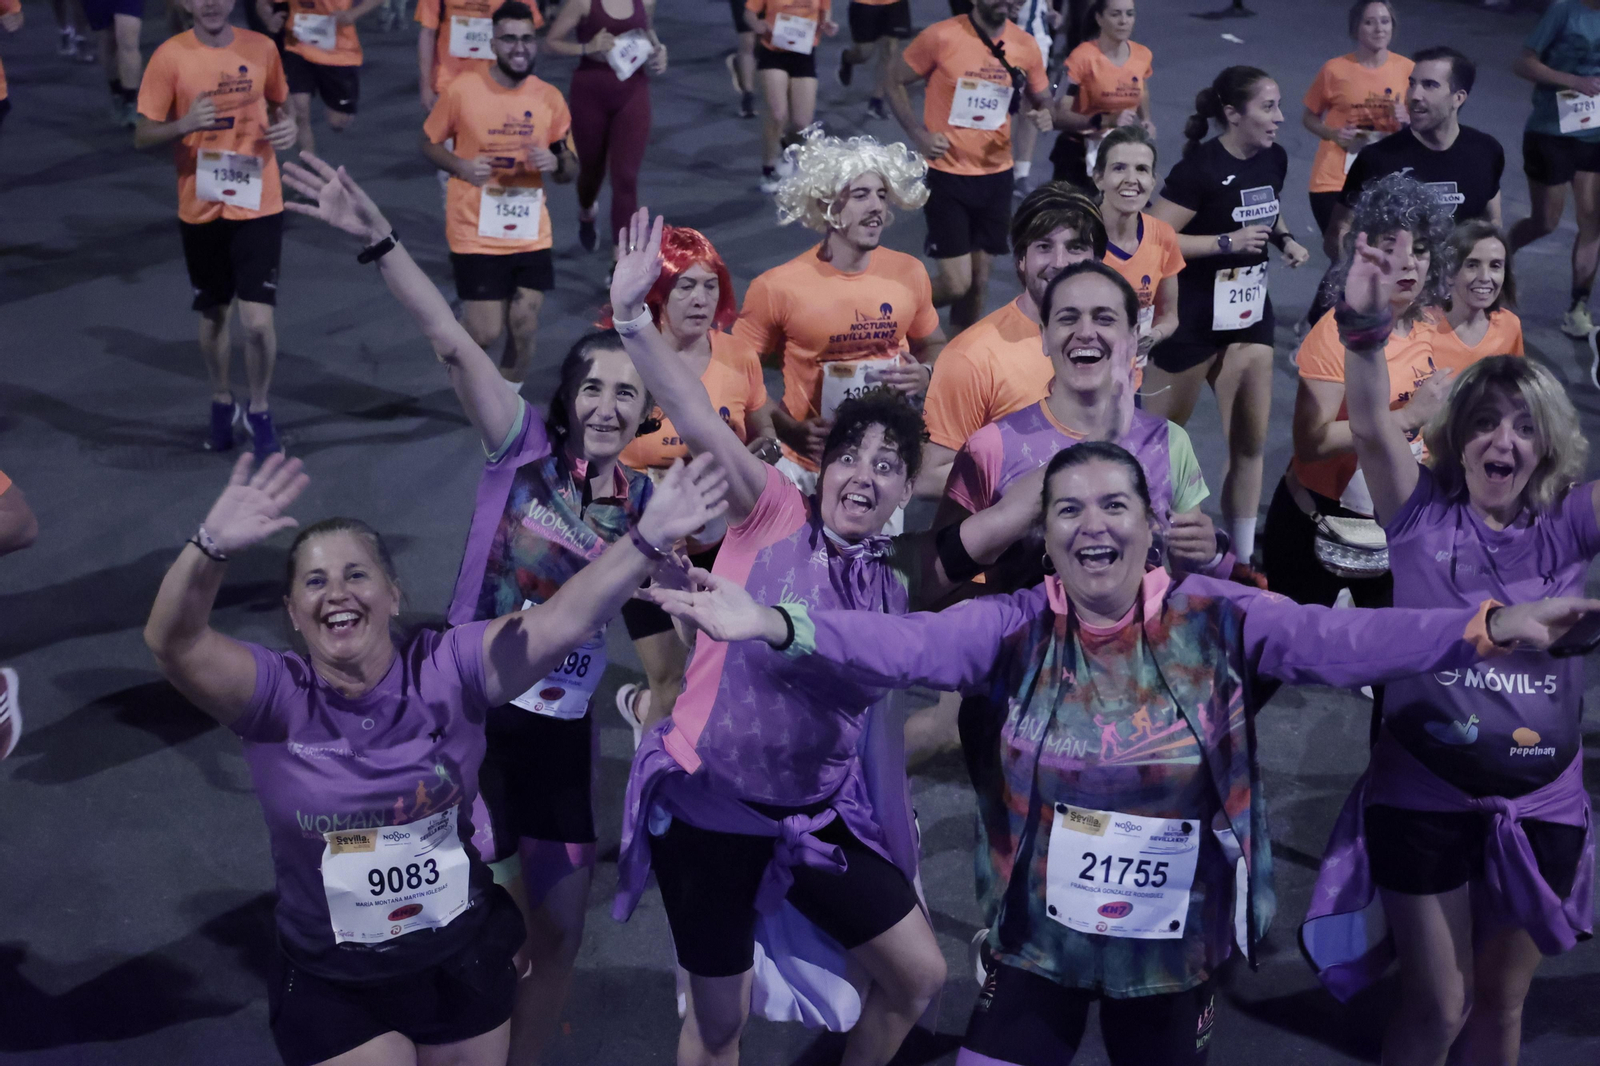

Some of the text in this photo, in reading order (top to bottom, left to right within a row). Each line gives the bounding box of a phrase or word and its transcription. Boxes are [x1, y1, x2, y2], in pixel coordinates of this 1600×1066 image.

[967, 96, 999, 110] 11549
[495, 203, 530, 218] 15424
[1239, 203, 1278, 219] TRIATLÓN
[1229, 284, 1261, 304] 21671
[850, 321, 898, 331] NOCTURNA
[829, 331, 872, 343] SEVILLA
[528, 498, 593, 550] WOMAN
[1463, 667, 1558, 695] MÓVIL-5
[1045, 735, 1087, 758] MAN
[296, 809, 386, 834] WOMAN
[368, 858, 440, 897] 9083
[1079, 851, 1169, 889] 21755
[1070, 882, 1102, 894] FRANCISCA
[1102, 887, 1133, 898] GONZALEZ
[375, 896, 403, 906] MONTAÑA
[404, 891, 425, 902] MARTÍN
[1101, 904, 1128, 916] KH7
